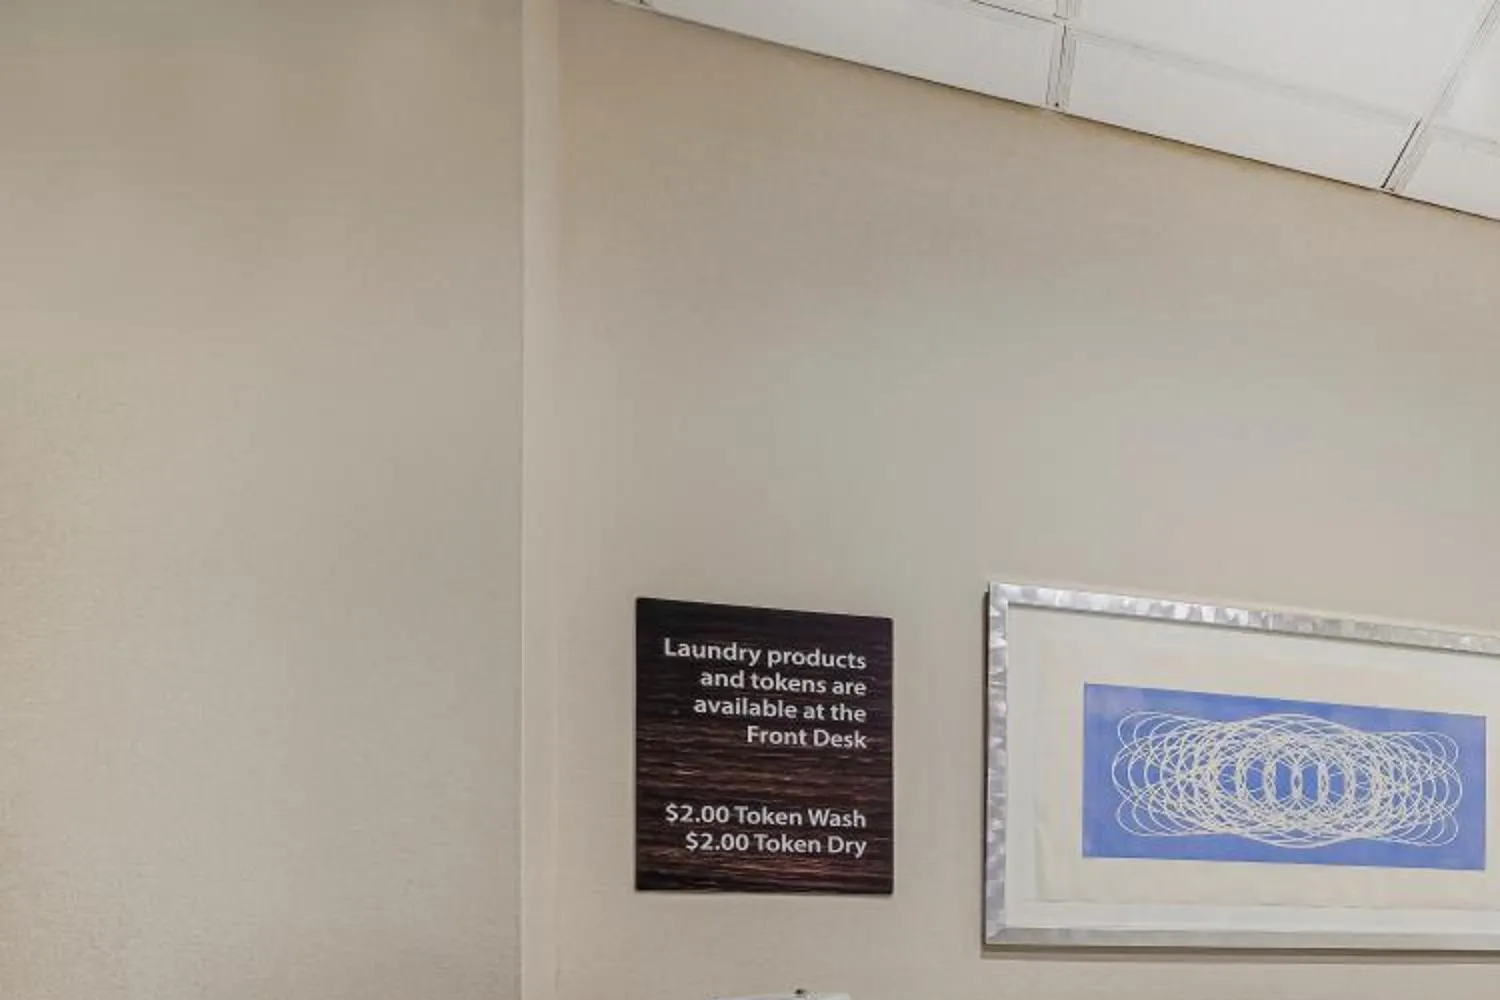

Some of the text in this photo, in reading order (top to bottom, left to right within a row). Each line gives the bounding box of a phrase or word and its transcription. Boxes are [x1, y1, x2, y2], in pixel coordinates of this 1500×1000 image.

[664, 637, 868, 670] Laundry products
[700, 670, 867, 696] and tokens are
[693, 698, 867, 723] available at the
[747, 725, 868, 749] Front Desk
[665, 803, 867, 828] $2.00 Token Wash
[685, 831, 867, 858] $2.00 Token Dry
